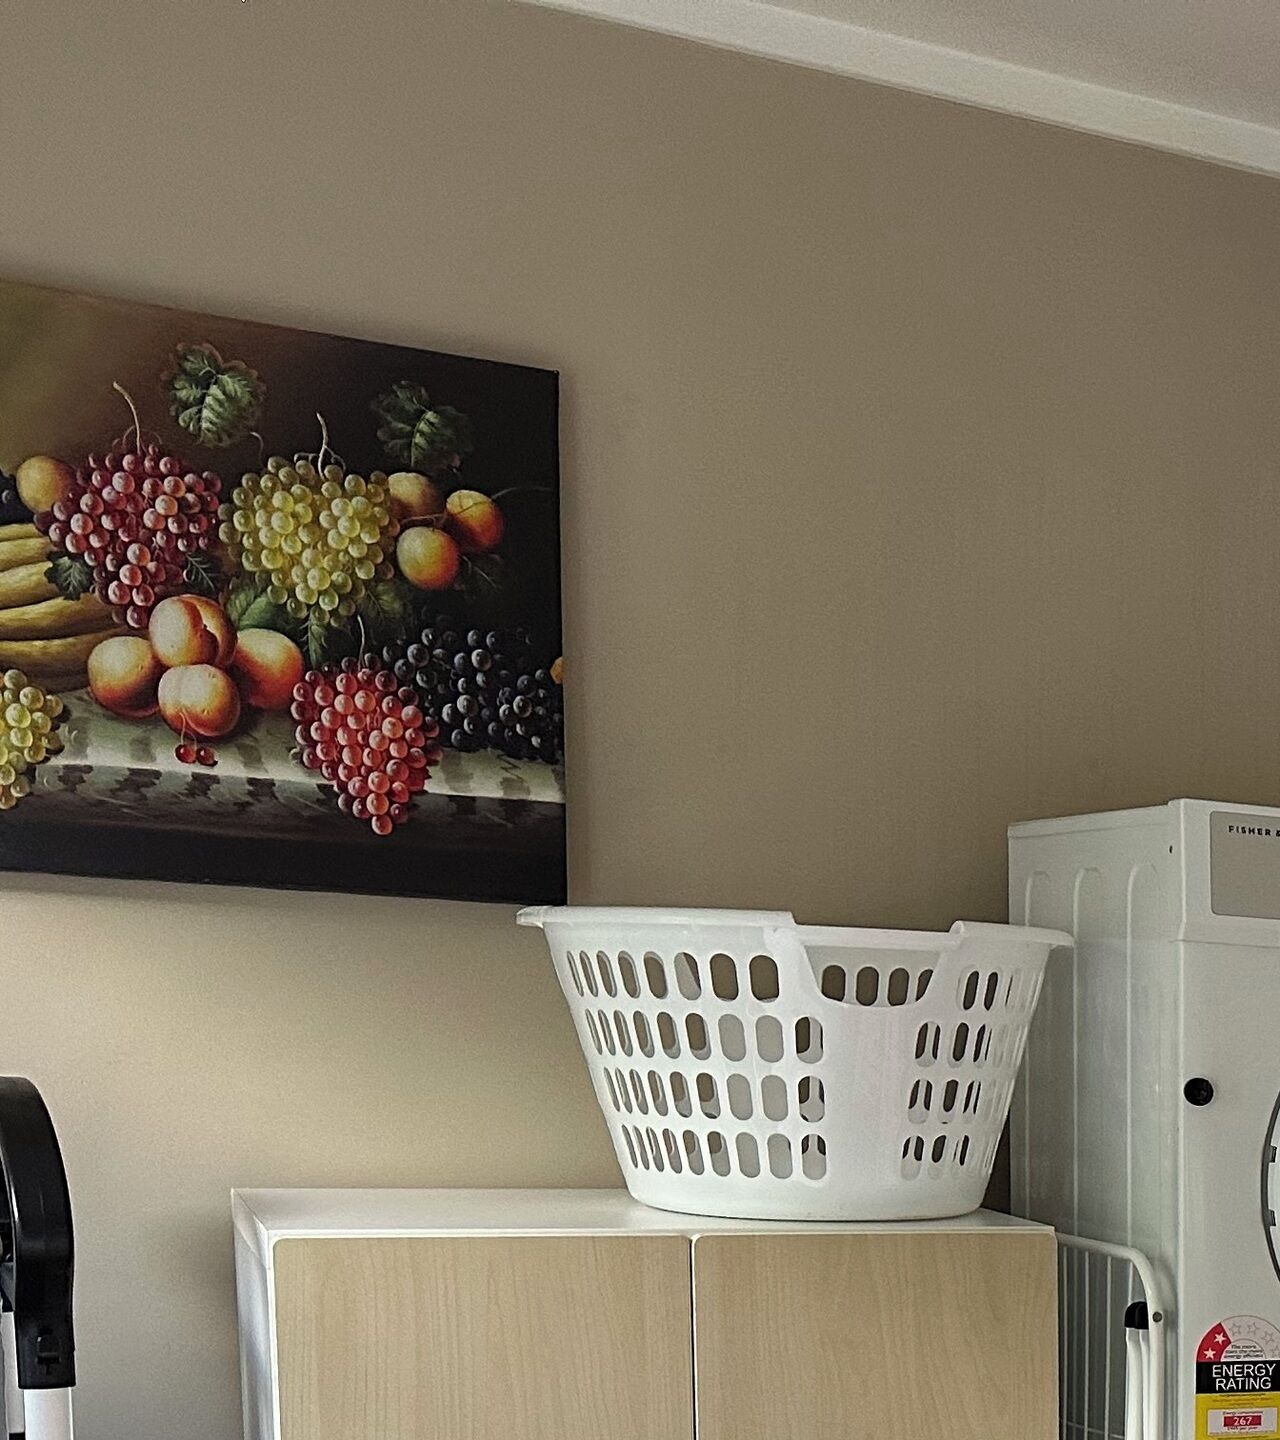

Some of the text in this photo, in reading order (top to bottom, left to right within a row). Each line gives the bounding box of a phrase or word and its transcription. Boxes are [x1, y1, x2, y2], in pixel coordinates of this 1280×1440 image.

[1228, 825, 1271, 837] FISHER
[1212, 1363, 1276, 1378] ENERGY
[1215, 1376, 1272, 1391] RATING
[1233, 1416, 1253, 1426] 267
